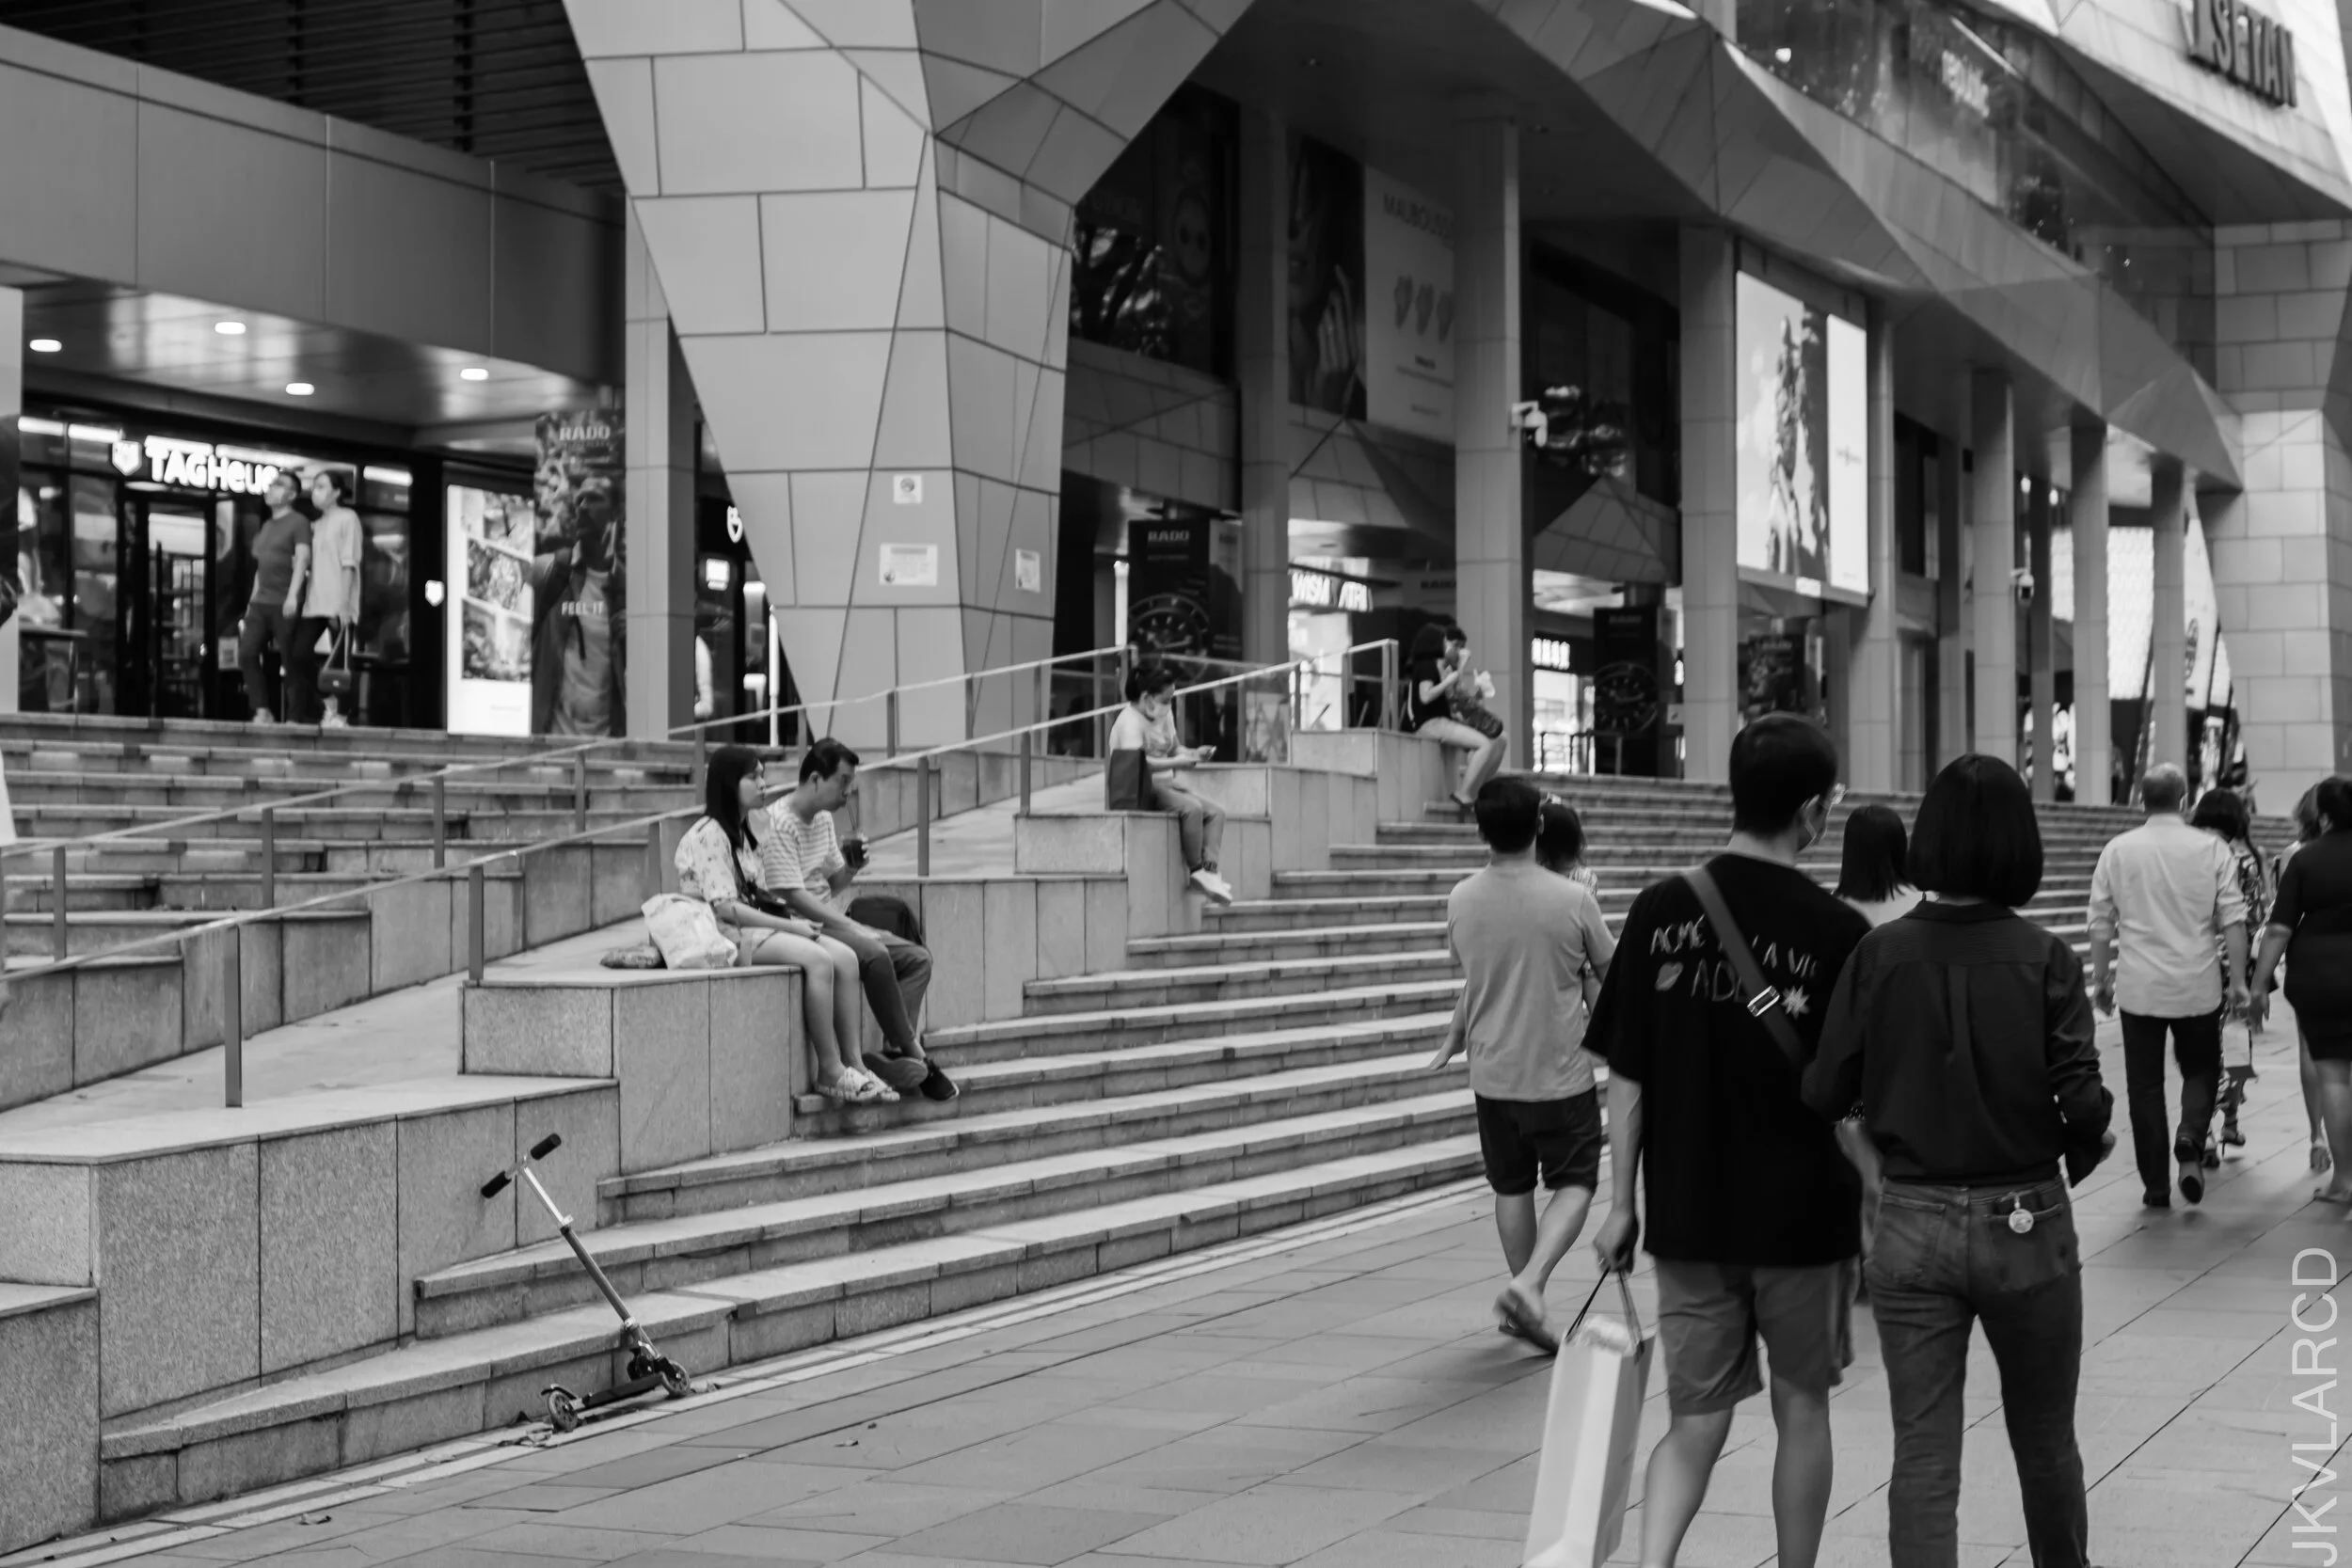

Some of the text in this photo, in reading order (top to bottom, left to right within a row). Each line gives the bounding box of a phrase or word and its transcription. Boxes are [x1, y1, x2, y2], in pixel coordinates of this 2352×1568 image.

[559, 425, 611, 441] RADO
[561, 600, 604, 616] FEEL IT
